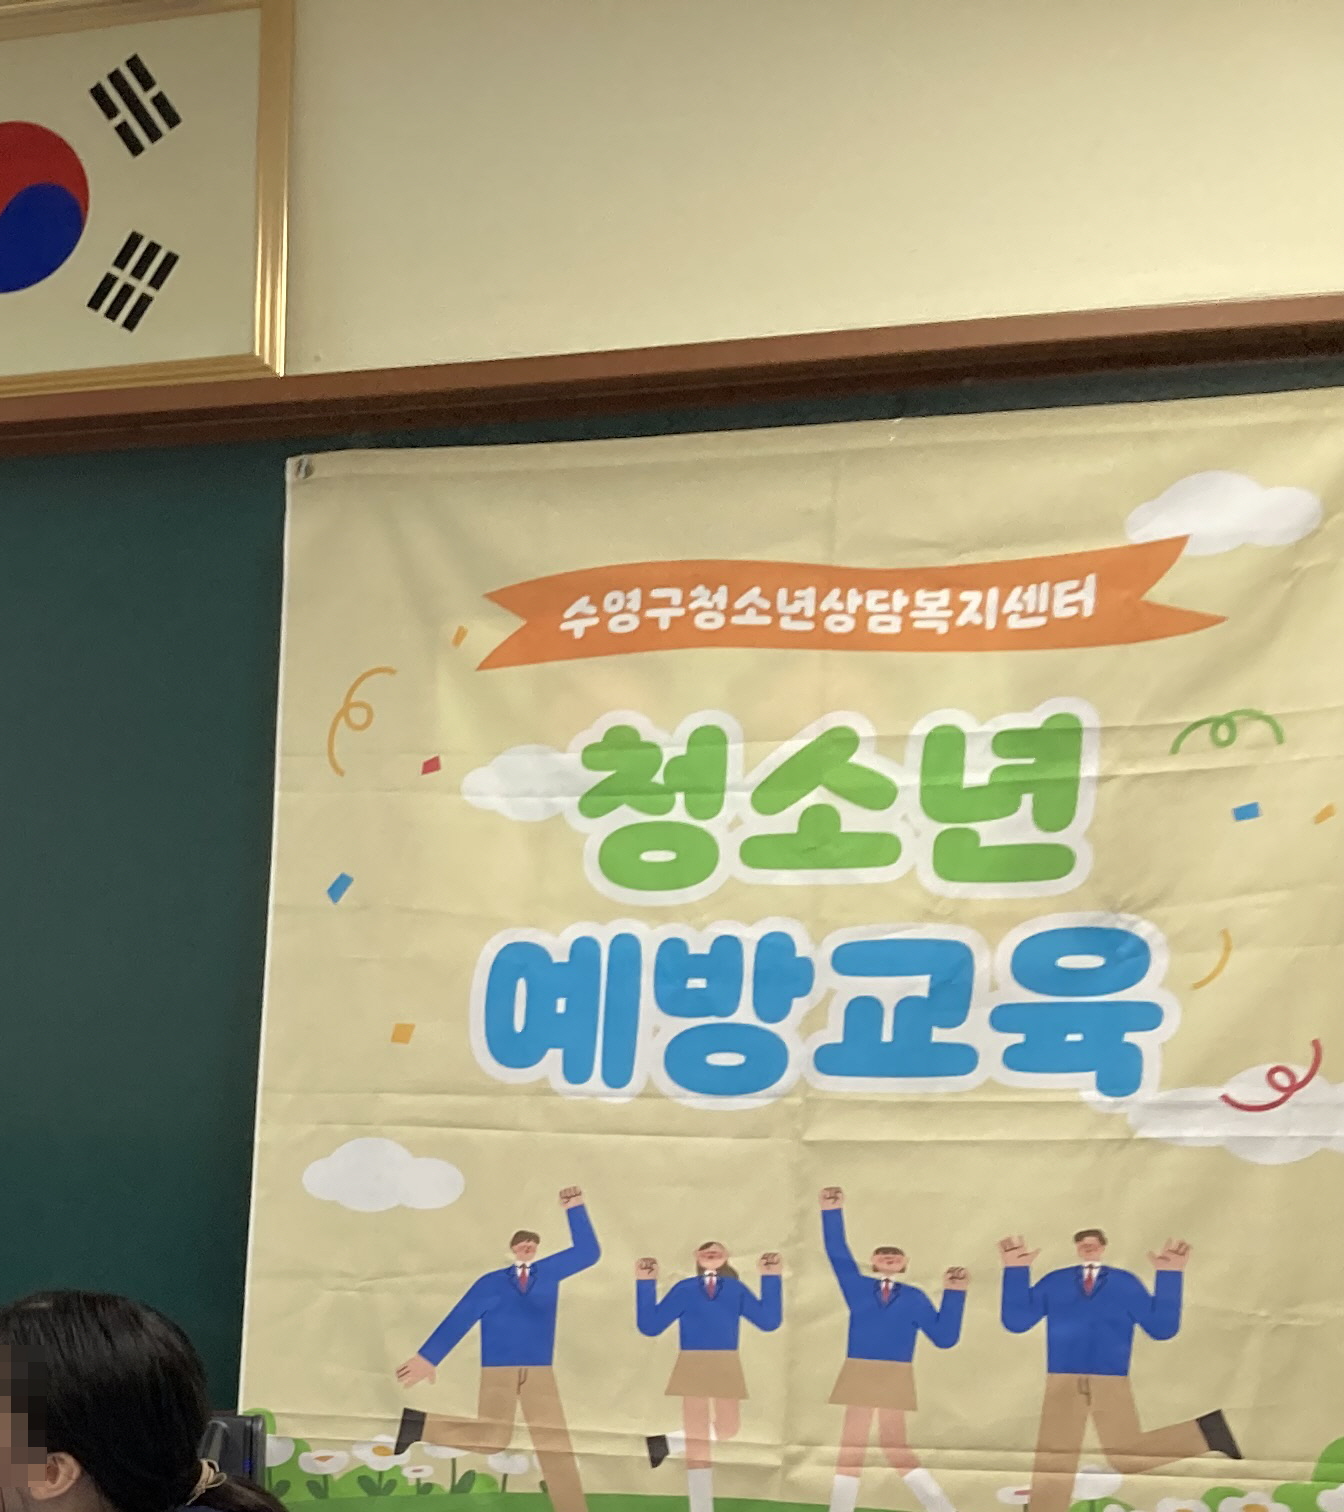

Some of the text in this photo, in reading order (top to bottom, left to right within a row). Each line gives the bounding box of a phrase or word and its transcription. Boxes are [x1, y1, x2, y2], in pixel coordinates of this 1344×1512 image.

[560, 574, 1097, 639] 수영구청소년상담복지센터
[578, 712, 1083, 892] 청소년
[485, 926, 1165, 1098] 예방교육
